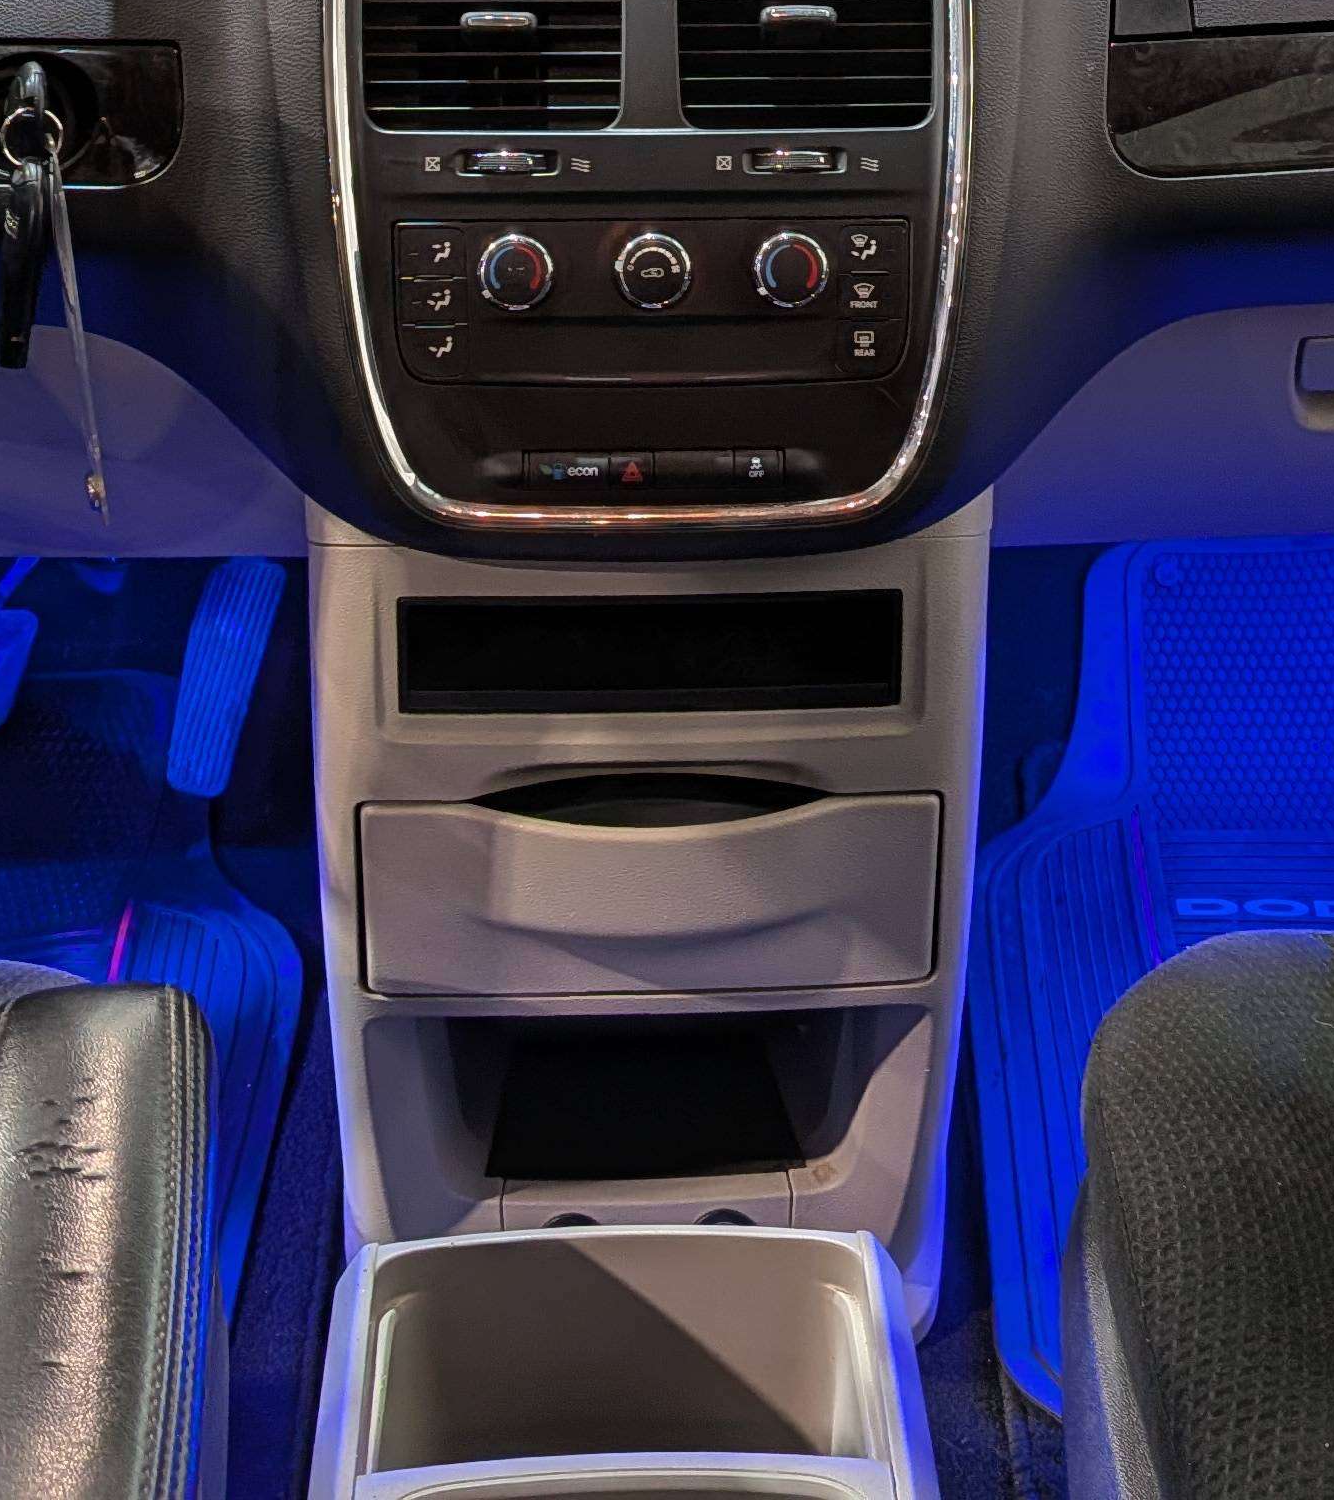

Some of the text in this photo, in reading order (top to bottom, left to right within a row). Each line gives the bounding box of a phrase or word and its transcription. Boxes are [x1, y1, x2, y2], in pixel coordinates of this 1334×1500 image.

[850, 300, 878, 309] FRONT
[854, 348, 875, 356] REAR
[567, 465, 599, 477] econ
[749, 470, 765, 478] OFF
